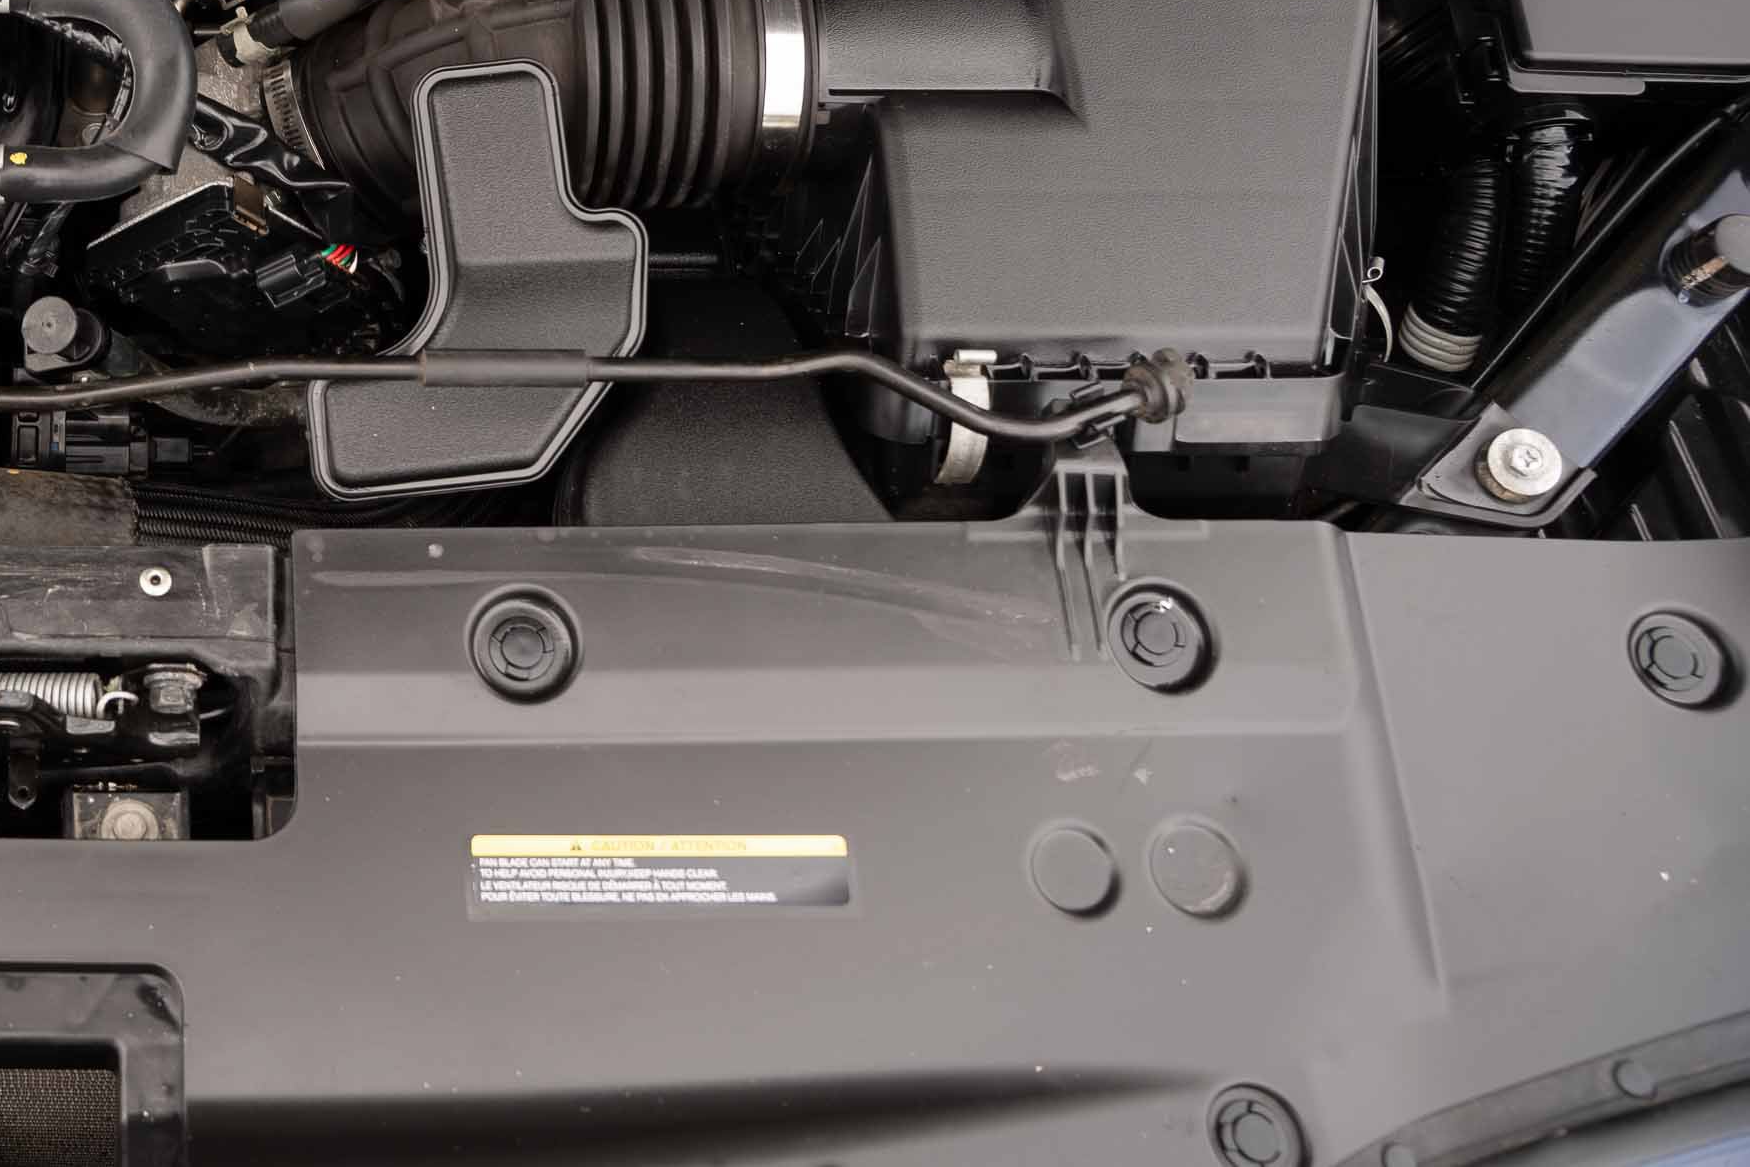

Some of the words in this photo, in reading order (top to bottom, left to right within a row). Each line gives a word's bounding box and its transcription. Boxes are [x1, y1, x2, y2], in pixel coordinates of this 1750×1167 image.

[592, 841, 655, 851] CAUTION
[671, 841, 747, 851] ATTENTION
[479, 868, 493, 878] TO
